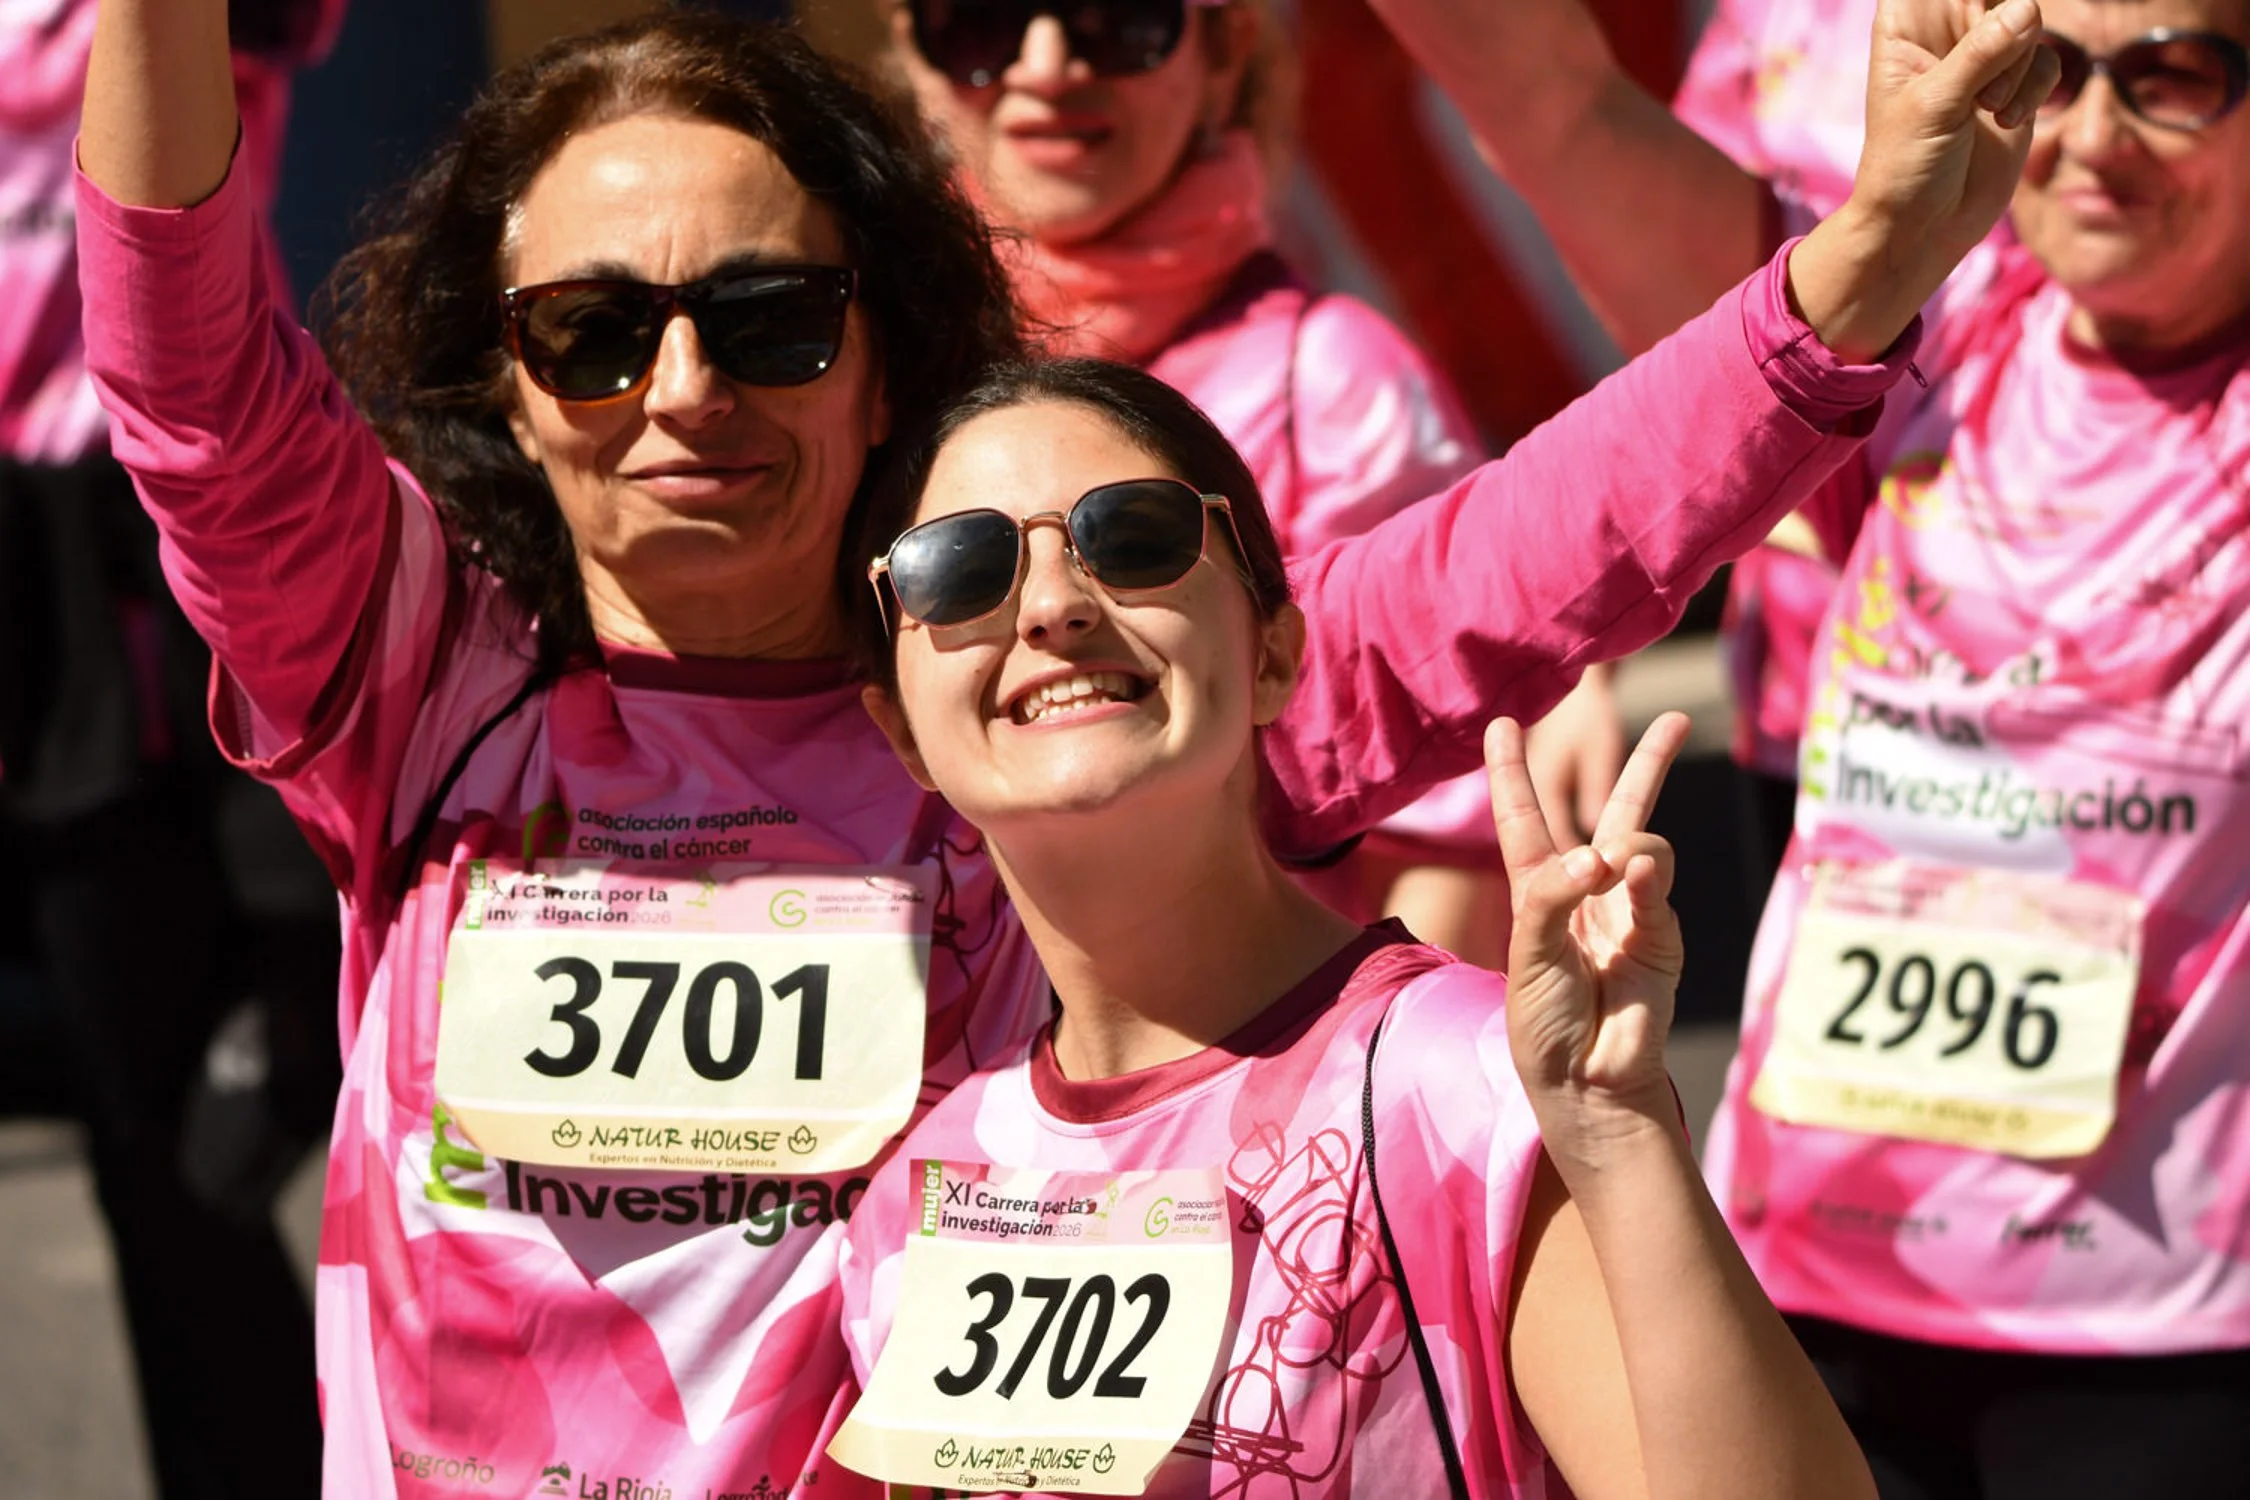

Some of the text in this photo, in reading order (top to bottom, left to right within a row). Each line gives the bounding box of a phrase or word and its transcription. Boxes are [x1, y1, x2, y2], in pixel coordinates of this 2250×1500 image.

[1838, 752, 2197, 840] Investigación
[578, 805, 798, 833] asociación española
[578, 835, 752, 859] contra el cáncer
[523, 884, 600, 901] Crrera
[608, 889, 643, 907] por
[649, 886, 668, 902] la
[487, 904, 628, 923] invtigación
[523, 956, 830, 1081] 3701
[1823, 947, 2061, 1071] 2996
[589, 1125, 780, 1151] NATUR HOUSE
[589, 1153, 639, 1166] Expertos
[659, 1155, 713, 1167] Nutrición
[725, 1156, 777, 1168] Dietética
[922, 1164, 940, 1231] mujer
[945, 1180, 971, 1206] XI
[976, 1192, 1038, 1213] Carrera
[1041, 1200, 1065, 1217] por
[941, 1211, 1053, 1238] investigación
[933, 1272, 1171, 1400] 3702
[390, 1441, 495, 1484] Logroño
[1030, 1446, 1091, 1470] HOUSE
[578, 1473, 608, 1500] La
